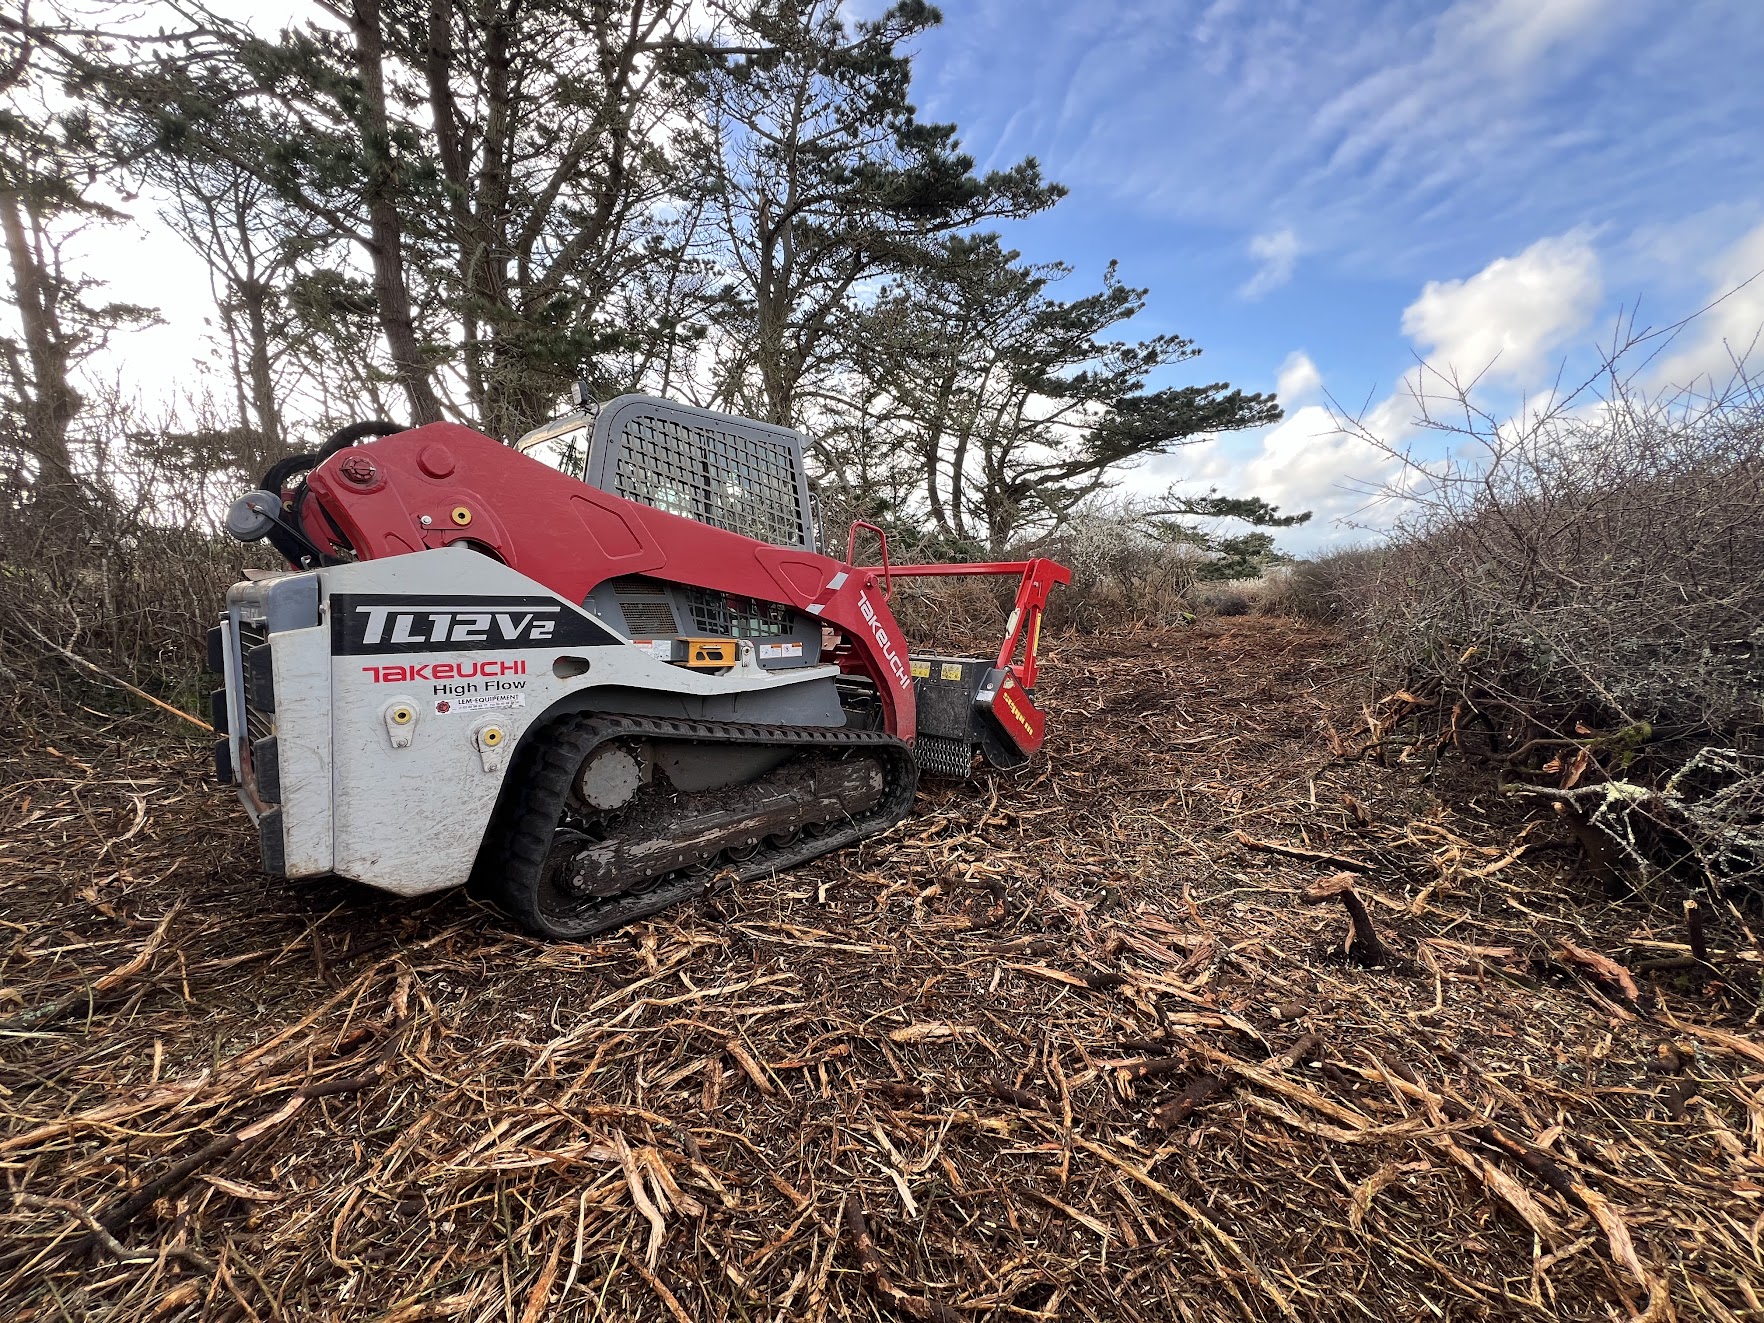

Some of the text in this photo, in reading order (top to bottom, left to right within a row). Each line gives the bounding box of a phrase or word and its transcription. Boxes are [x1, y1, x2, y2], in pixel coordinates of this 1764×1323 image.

[858, 589, 911, 690] TAKEUCHI
[362, 660, 527, 683] TAKEUCHI
[433, 680, 527, 696] High Flow
